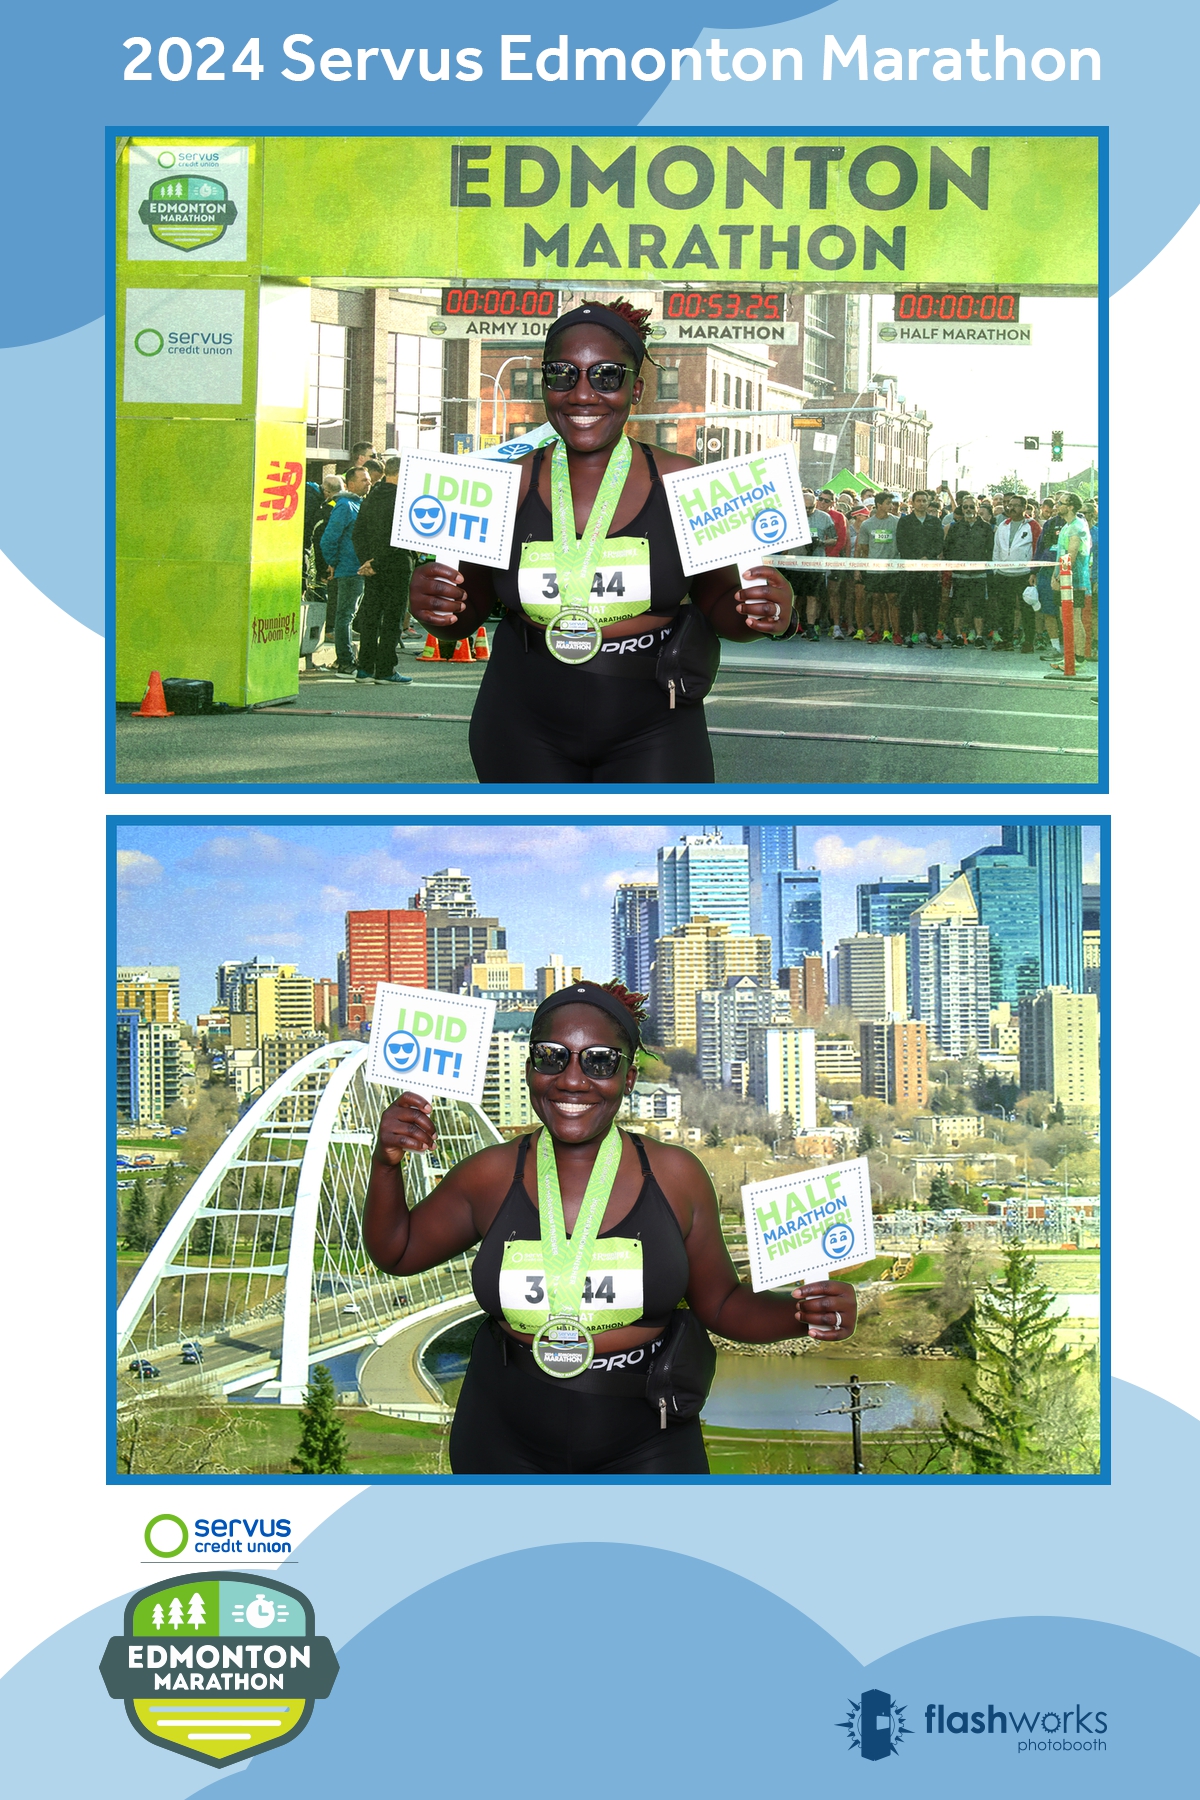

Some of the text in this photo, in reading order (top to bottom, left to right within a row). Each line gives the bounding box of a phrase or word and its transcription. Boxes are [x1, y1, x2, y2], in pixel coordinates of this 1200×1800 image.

[178, 152, 220, 161] servus
[450, 144, 990, 211] EDMONTON
[149, 203, 227, 214] EDMONTON
[160, 214, 216, 222] MARATHON
[523, 222, 907, 271] MARATHON
[168, 332, 233, 345] servus
[465, 321, 518, 335] ARMY
[678, 325, 785, 340] MARATHON
[900, 327, 1031, 341] HALF MARATHON
[168, 345, 233, 355] credit union
[423, 473, 493, 508] I DID
[679, 457, 767, 518] HALF
[689, 481, 776, 531] MARATHON
[693, 494, 783, 546] FINISHER!
[448, 511, 489, 543] IT!
[541, 571, 625, 599] 344
[597, 613, 634, 623] ARATHON
[397, 1008, 467, 1043] I DID
[422, 1047, 463, 1078] IT!
[755, 1171, 841, 1232] HALF
[763, 1195, 848, 1245] MARATHON
[766, 1208, 853, 1261] FINISHER!
[525, 1275, 616, 1304] 344
[586, 1321, 624, 1332] ARATHON
